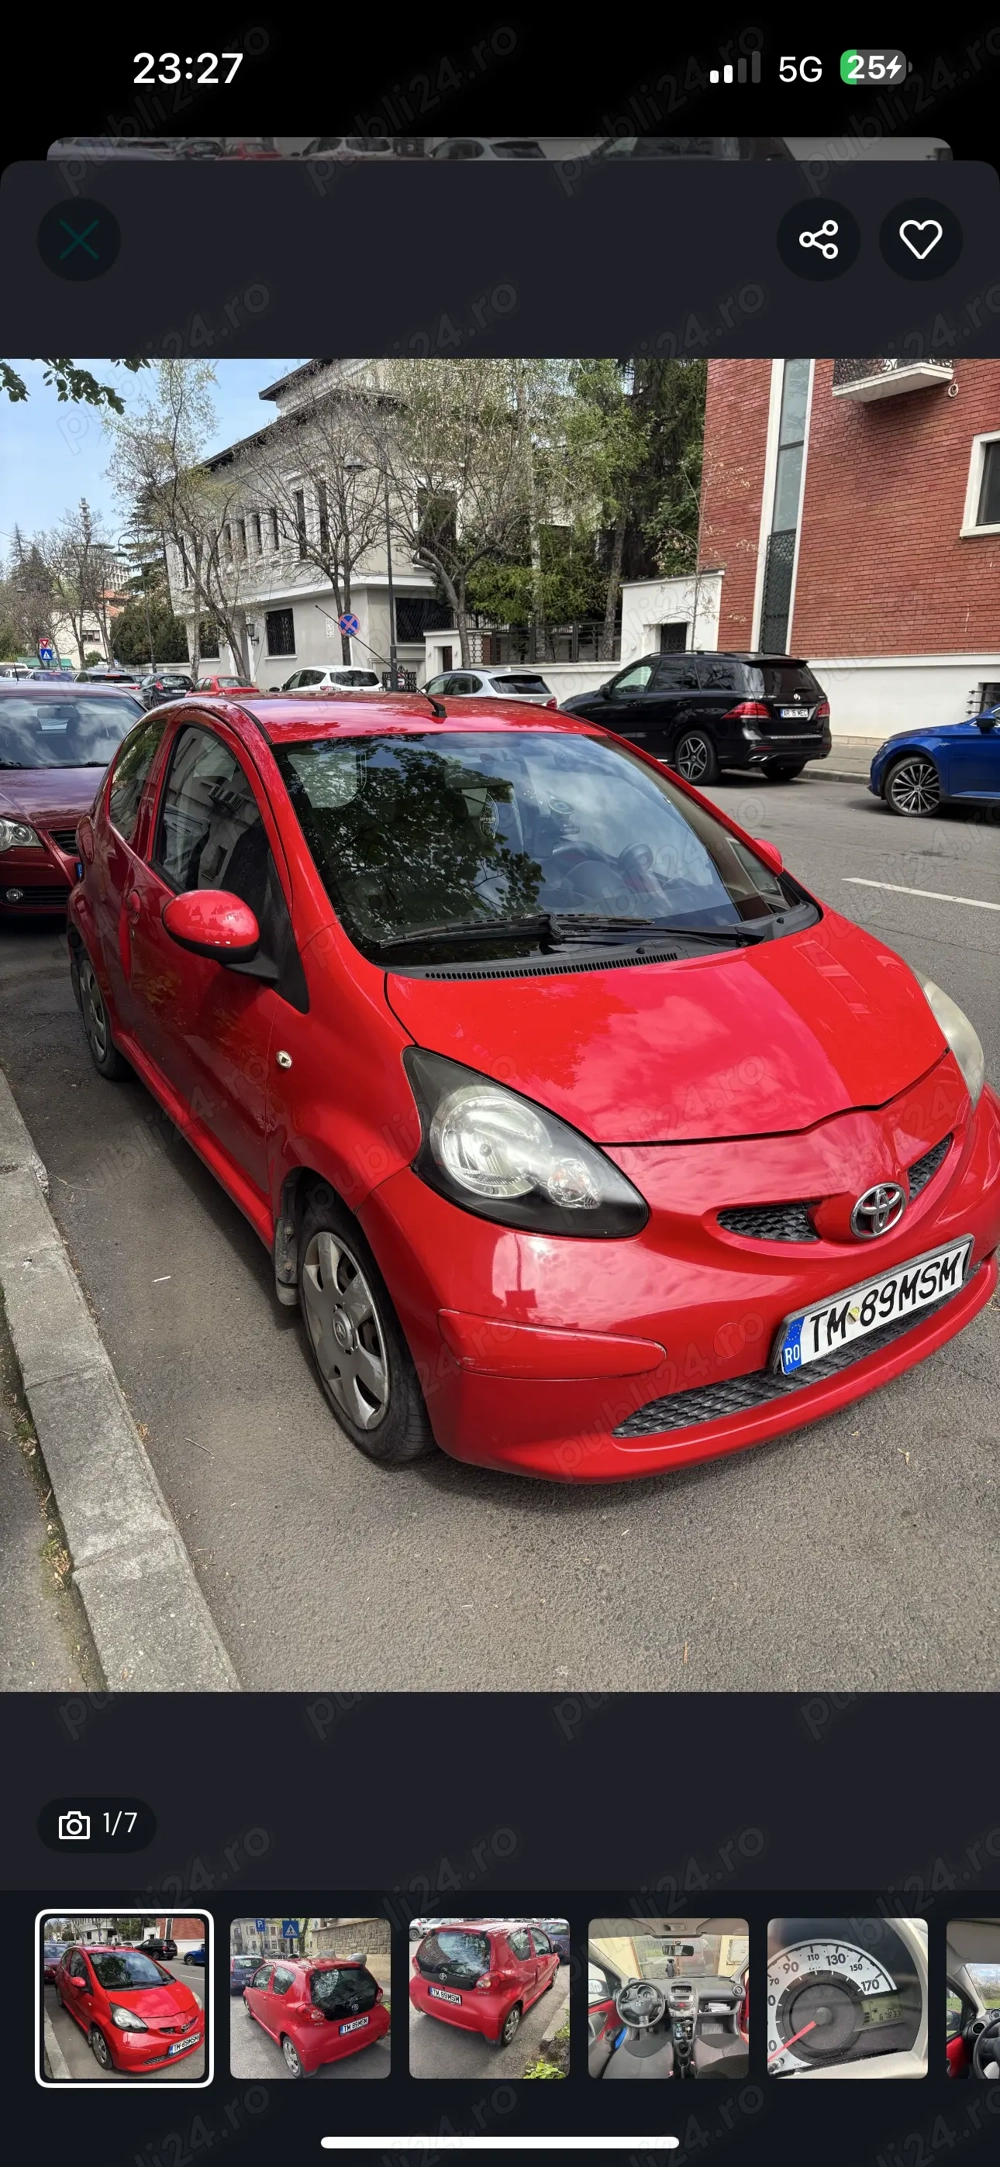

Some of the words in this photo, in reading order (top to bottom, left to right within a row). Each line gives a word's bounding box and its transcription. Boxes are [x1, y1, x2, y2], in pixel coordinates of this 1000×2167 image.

[133, 52, 243, 84] 23:27
[779, 55, 823, 83] 5G
[847, 55, 886, 80] 25
[810, 1301, 850, 1353] TM
[860, 1251, 962, 1327] 89MSM
[785, 1344, 800, 1366] RO
[103, 1810, 138, 1836] 1/7
[807, 1953, 820, 1961] 110
[825, 1953, 846, 1966] 130
[782, 1961, 799, 1975] 90
[849, 1963, 863, 1972] 150
[769, 1978, 780, 1986] 70
[860, 1979, 880, 1992] 170
